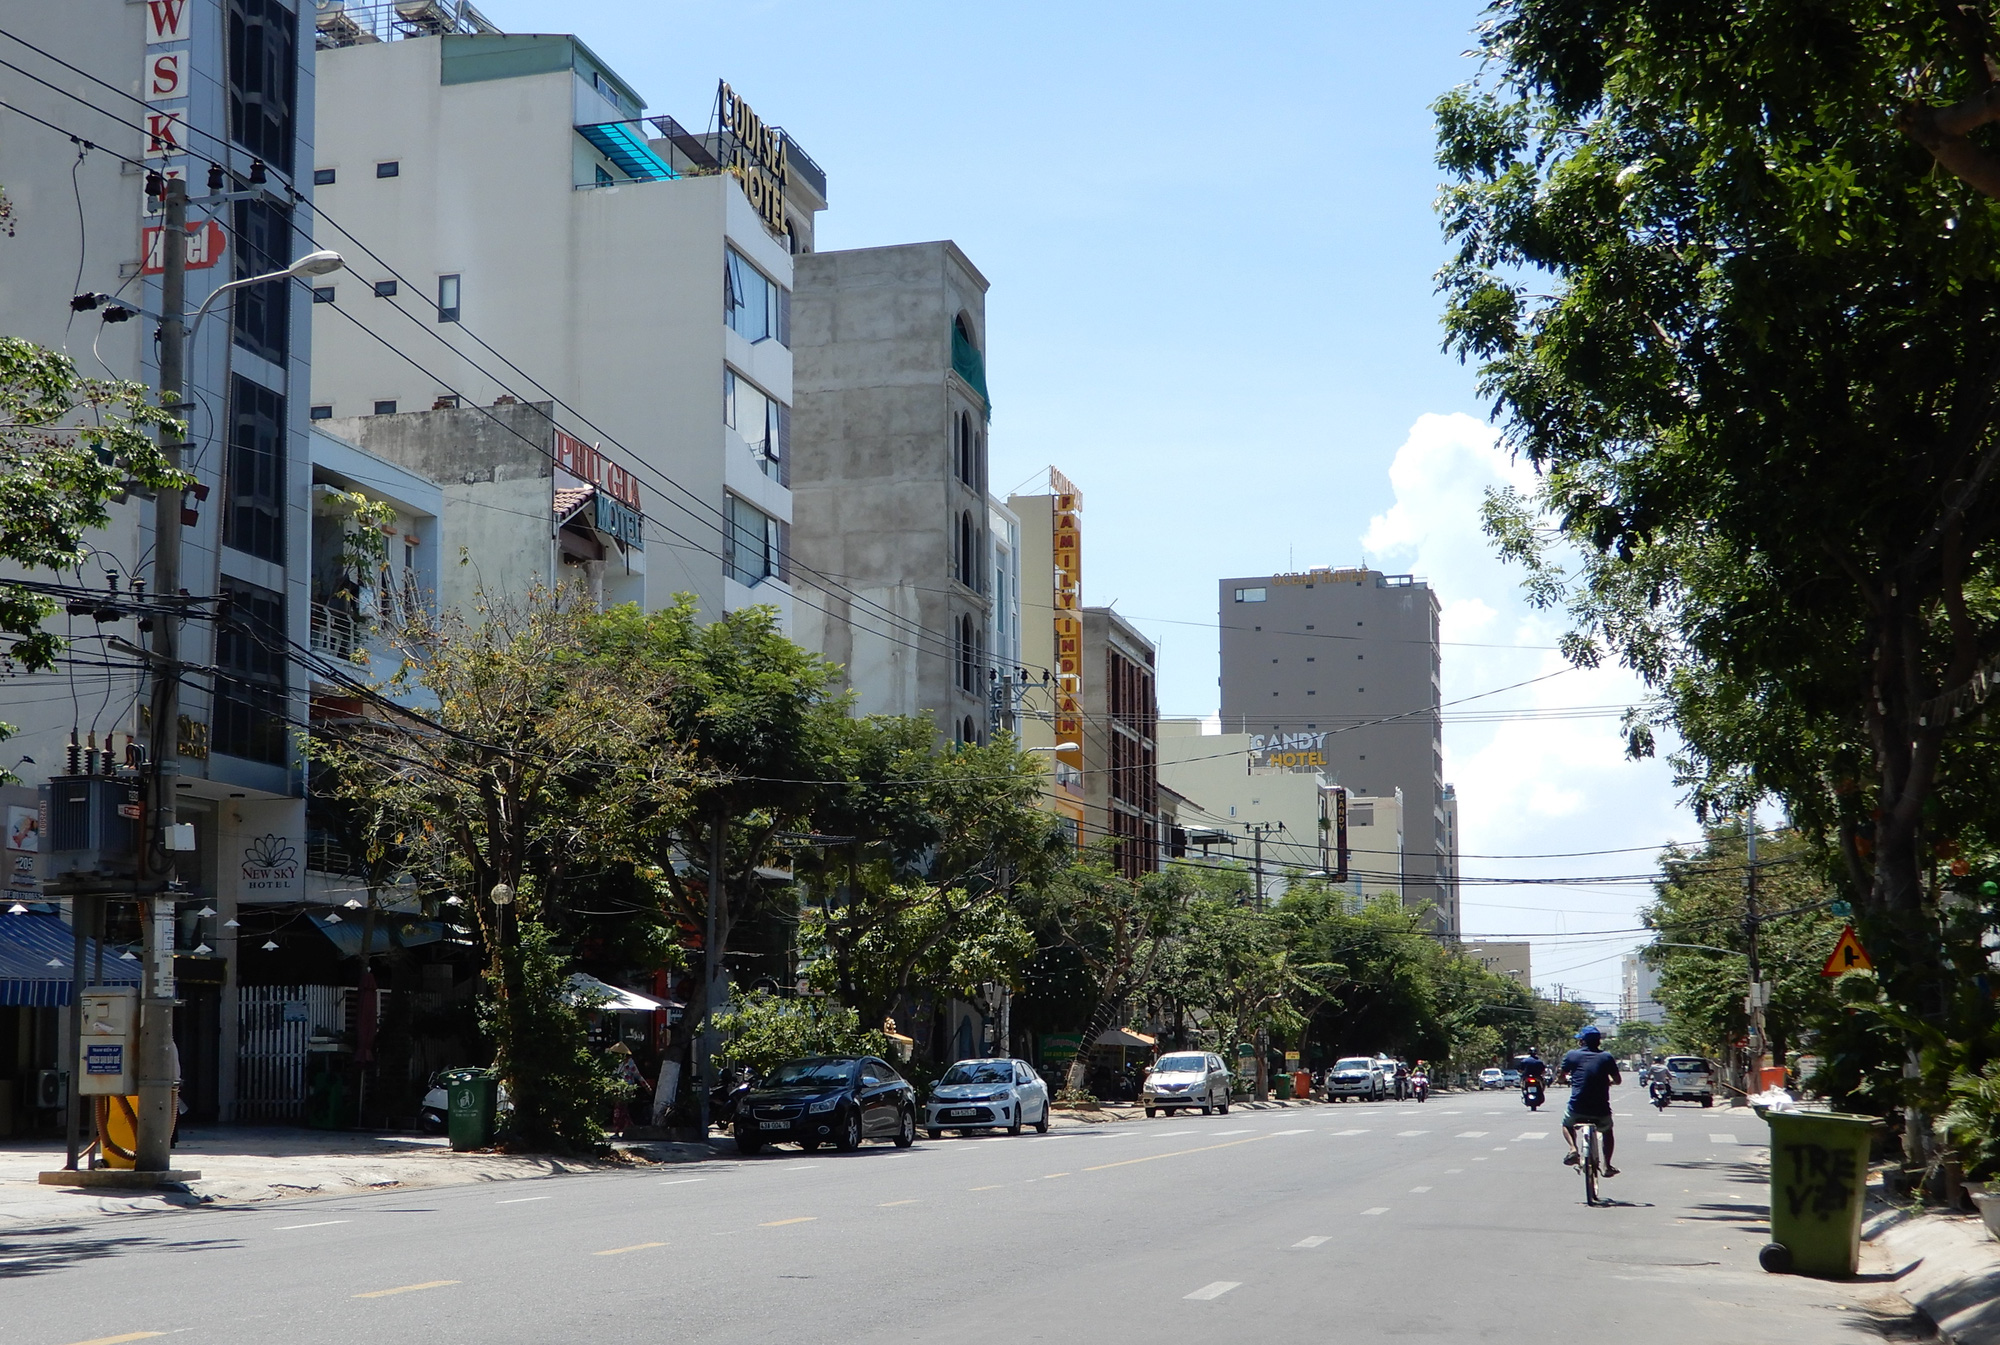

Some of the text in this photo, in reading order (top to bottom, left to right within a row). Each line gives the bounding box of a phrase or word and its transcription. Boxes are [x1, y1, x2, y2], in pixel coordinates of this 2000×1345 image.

[735, 150, 788, 235] HOTEL
[607, 461, 642, 512] GIA
[595, 492, 644, 552] MOTEL
[1272, 570, 1368, 586] OCEAN HAVEN
[1060, 496, 1075, 732] FAMILY INDIAN
[1251, 732, 1327, 751] CANDY
[1270, 752, 1327, 767] HOTEL
[243, 866, 298, 880] NEW SKY
[249, 881, 291, 889] HOTEL
[1784, 1143, 1857, 1185] TRE
